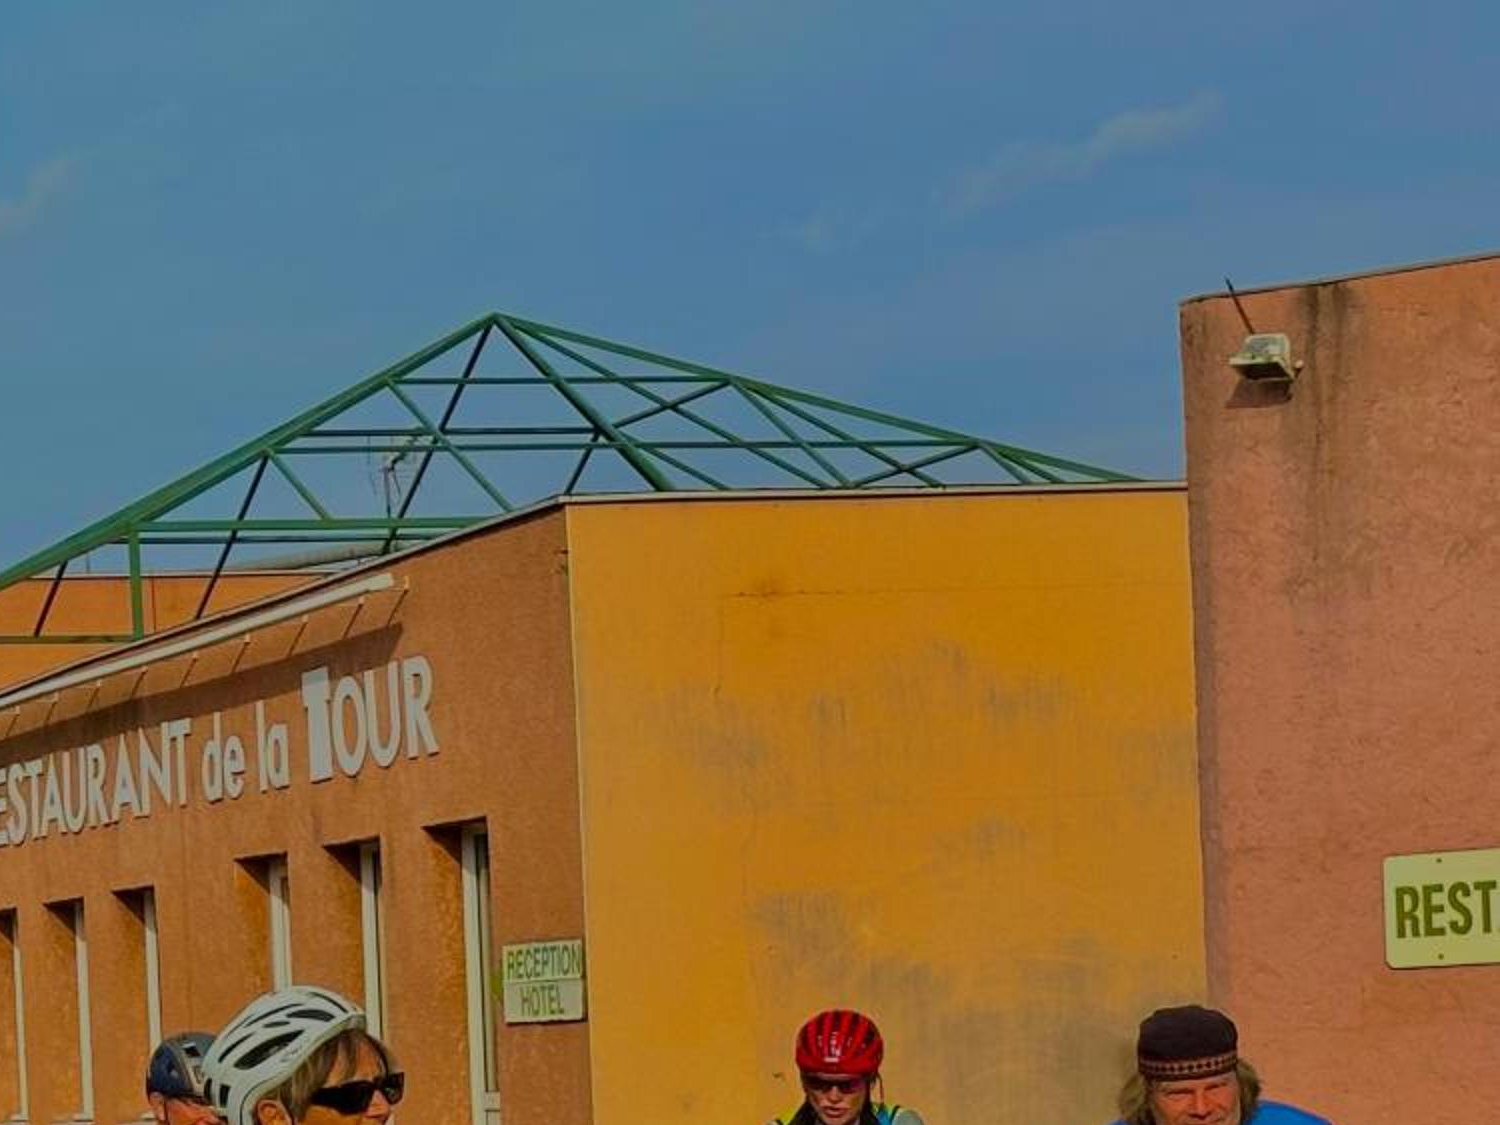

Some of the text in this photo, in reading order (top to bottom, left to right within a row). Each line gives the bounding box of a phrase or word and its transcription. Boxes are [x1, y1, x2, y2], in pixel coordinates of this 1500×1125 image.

[202, 711, 246, 801] de
[257, 701, 290, 792] la
[304, 656, 439, 782] TOUR
[1395, 880, 1500, 939] REST
[507, 944, 581, 979] RECEPTION
[520, 984, 565, 1017] HOTEL
